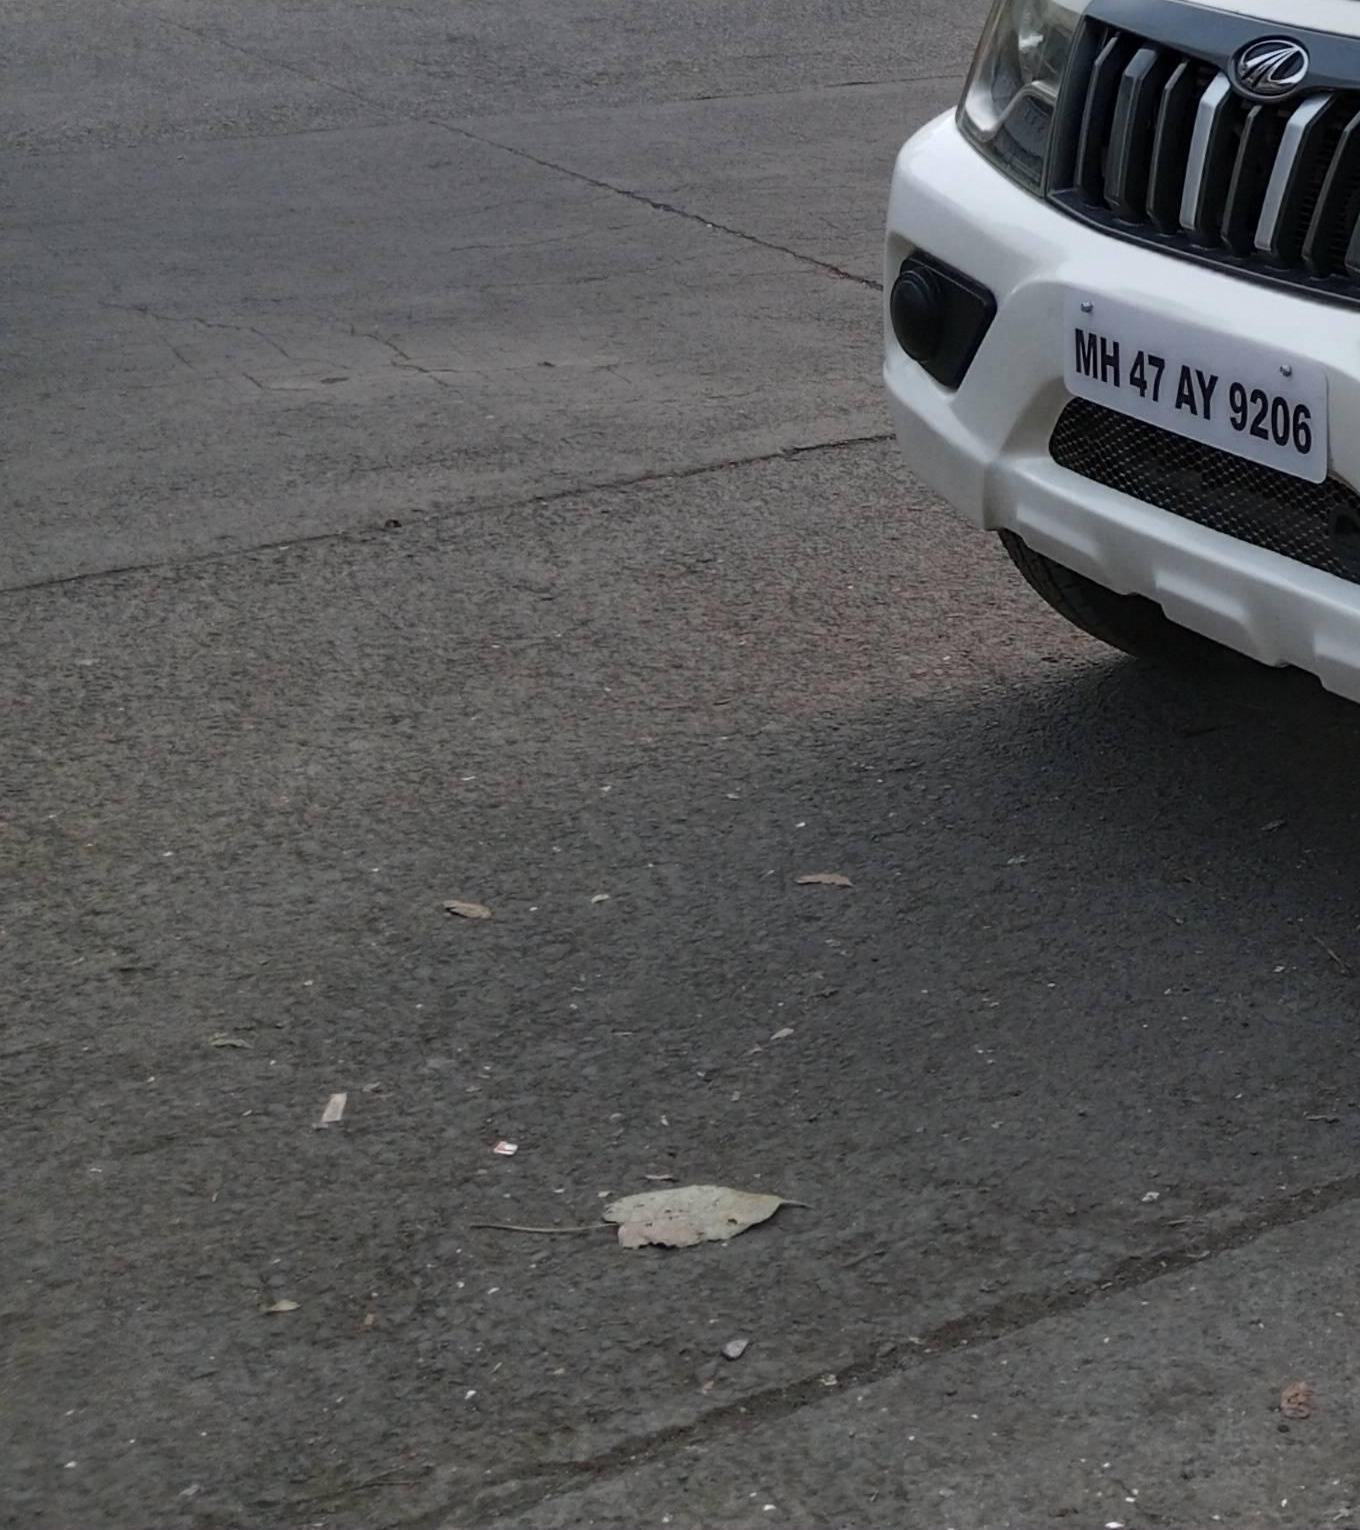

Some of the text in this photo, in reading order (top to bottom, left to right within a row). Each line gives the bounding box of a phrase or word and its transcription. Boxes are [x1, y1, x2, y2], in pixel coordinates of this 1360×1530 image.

[1074, 327, 1313, 455] MH 47 AY 9206
